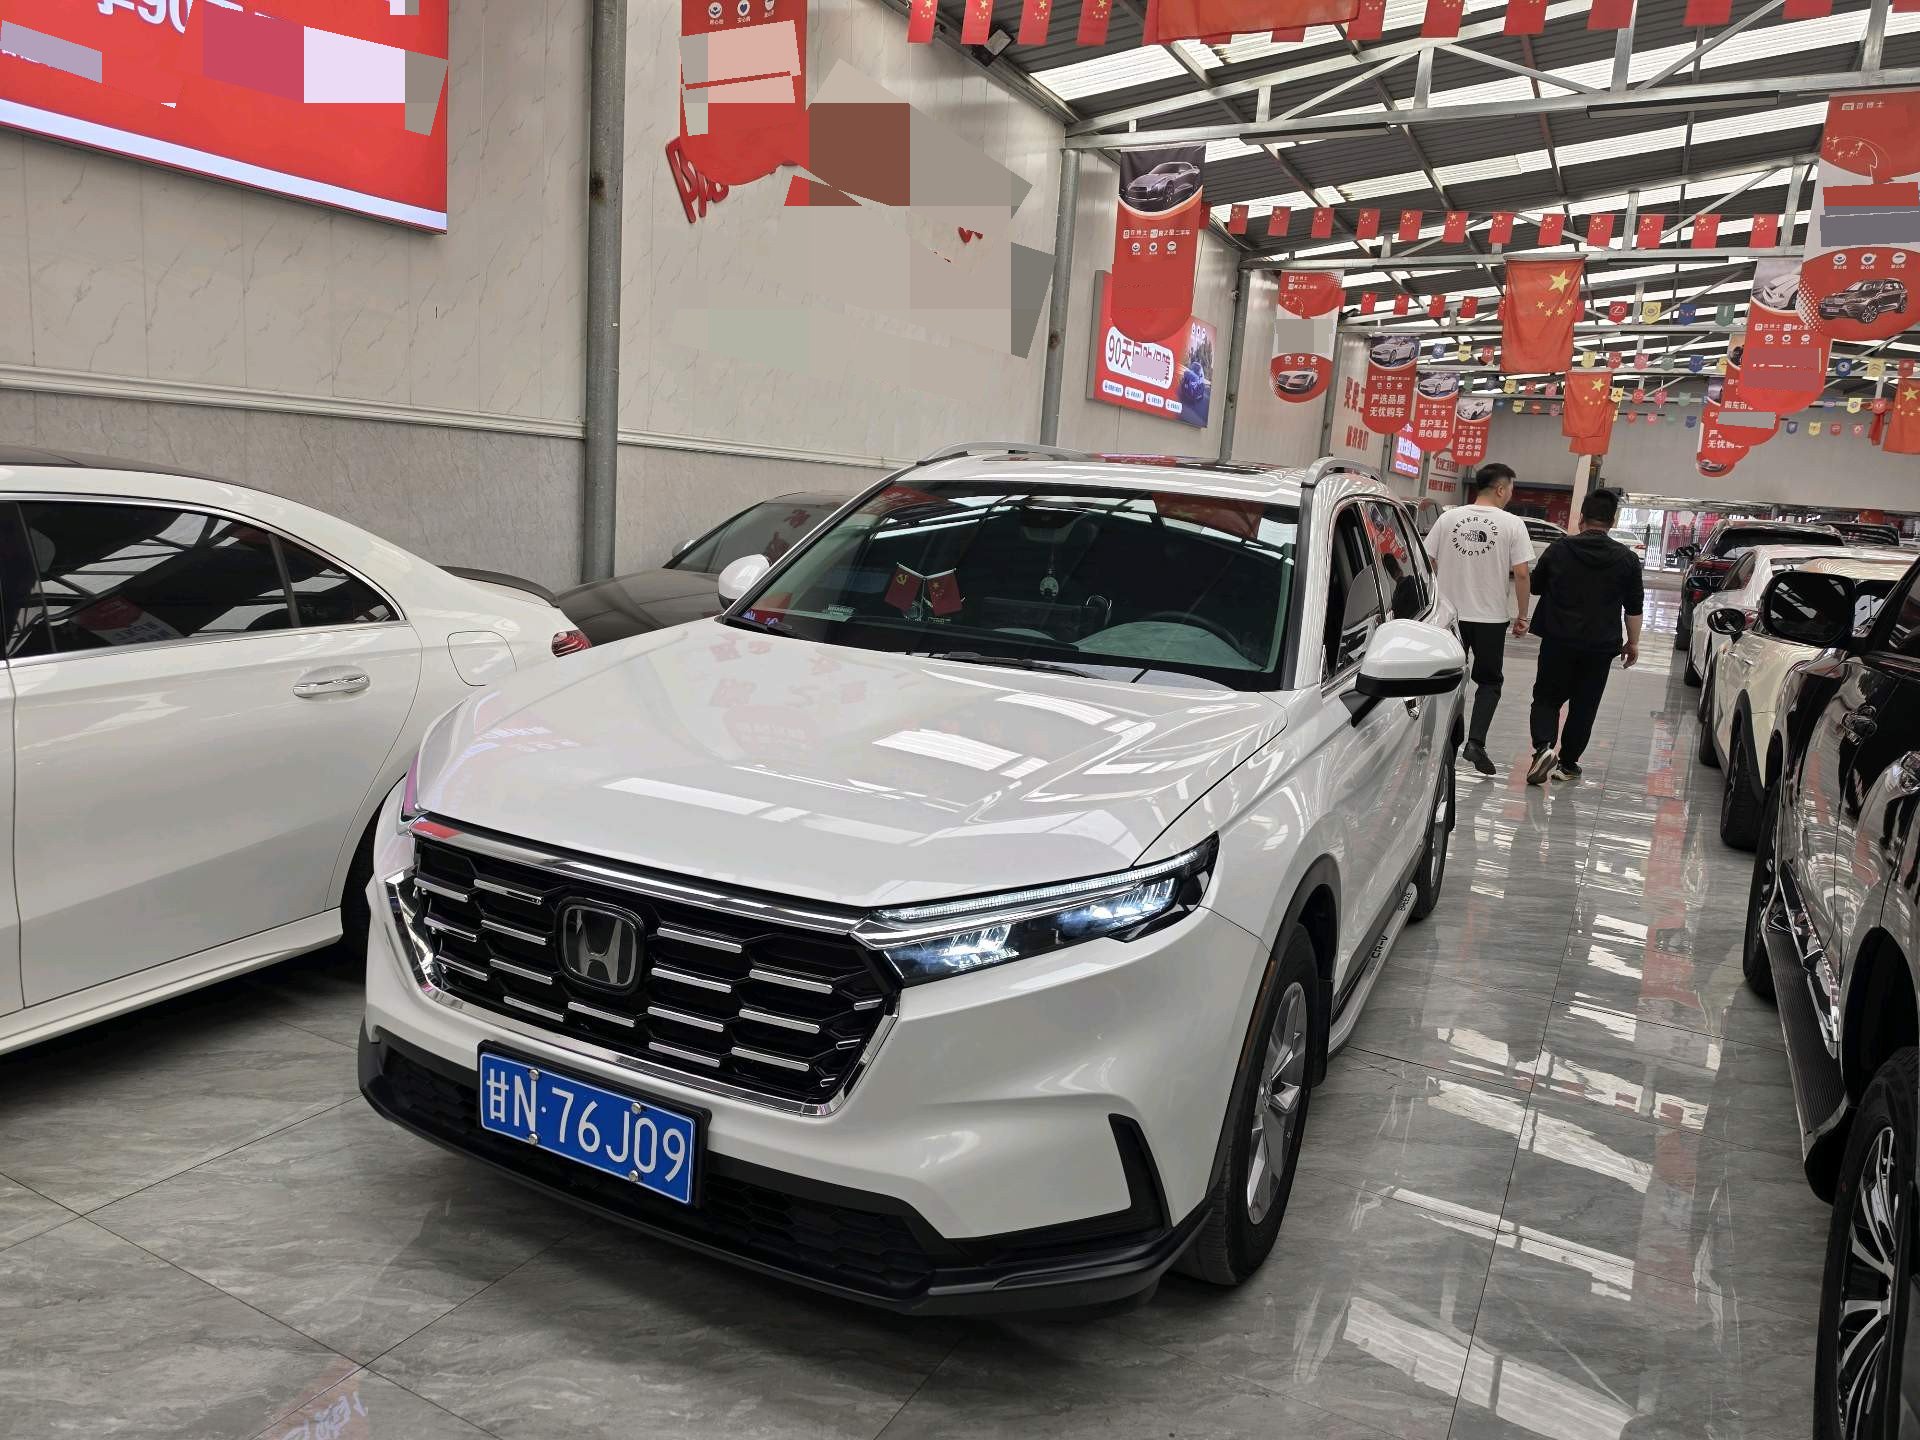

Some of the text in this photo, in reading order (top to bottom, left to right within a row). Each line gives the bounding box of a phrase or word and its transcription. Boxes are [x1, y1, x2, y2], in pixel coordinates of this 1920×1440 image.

[1452, 516, 1479, 534] NEVER
[1483, 518, 1499, 536] STOP
[1371, 936, 1388, 958] CR-V
